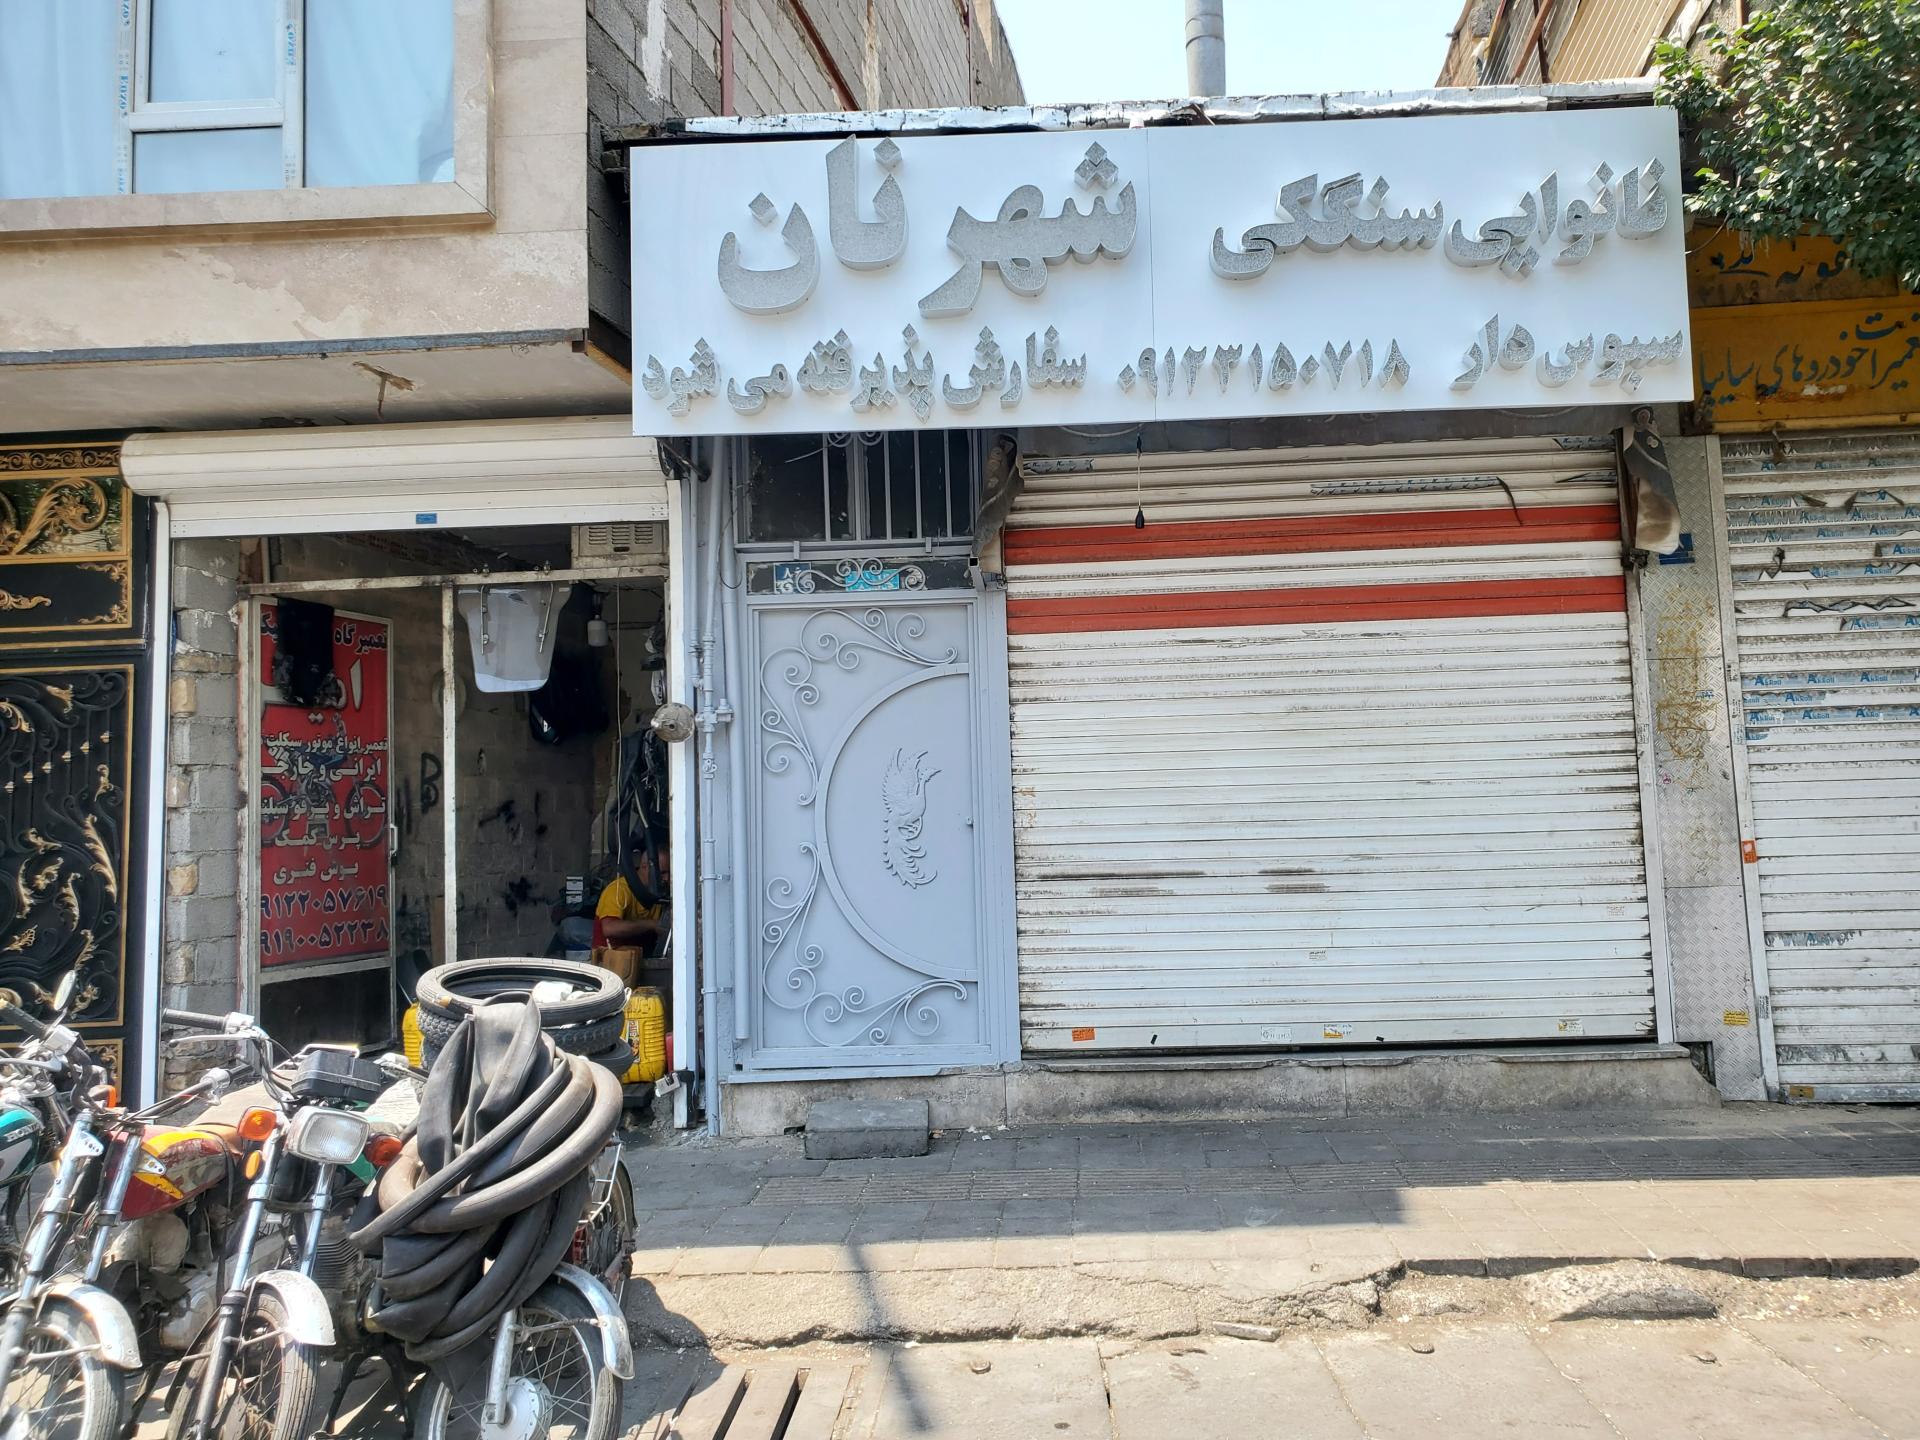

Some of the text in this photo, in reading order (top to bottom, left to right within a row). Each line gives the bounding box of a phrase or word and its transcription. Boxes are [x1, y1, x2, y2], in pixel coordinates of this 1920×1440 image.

[718, 134, 1668, 318] نانوایی سنگکی شهر نان
[641, 337, 722, 418] شود
[727, 363, 793, 417] می
[796, 323, 936, 425] پذیرفته
[942, 324, 1088, 411] سفارش
[1117, 337, 1411, 399] ۰۹۱۲۳۱۵۰۷۱۸
[1535, 329, 1684, 395] سبوس
[261, 755, 314, 781] خارج
[266, 731, 302, 750] سیکلت
[305, 734, 333, 753] موتور
[330, 757, 381, 781] ایرانی
